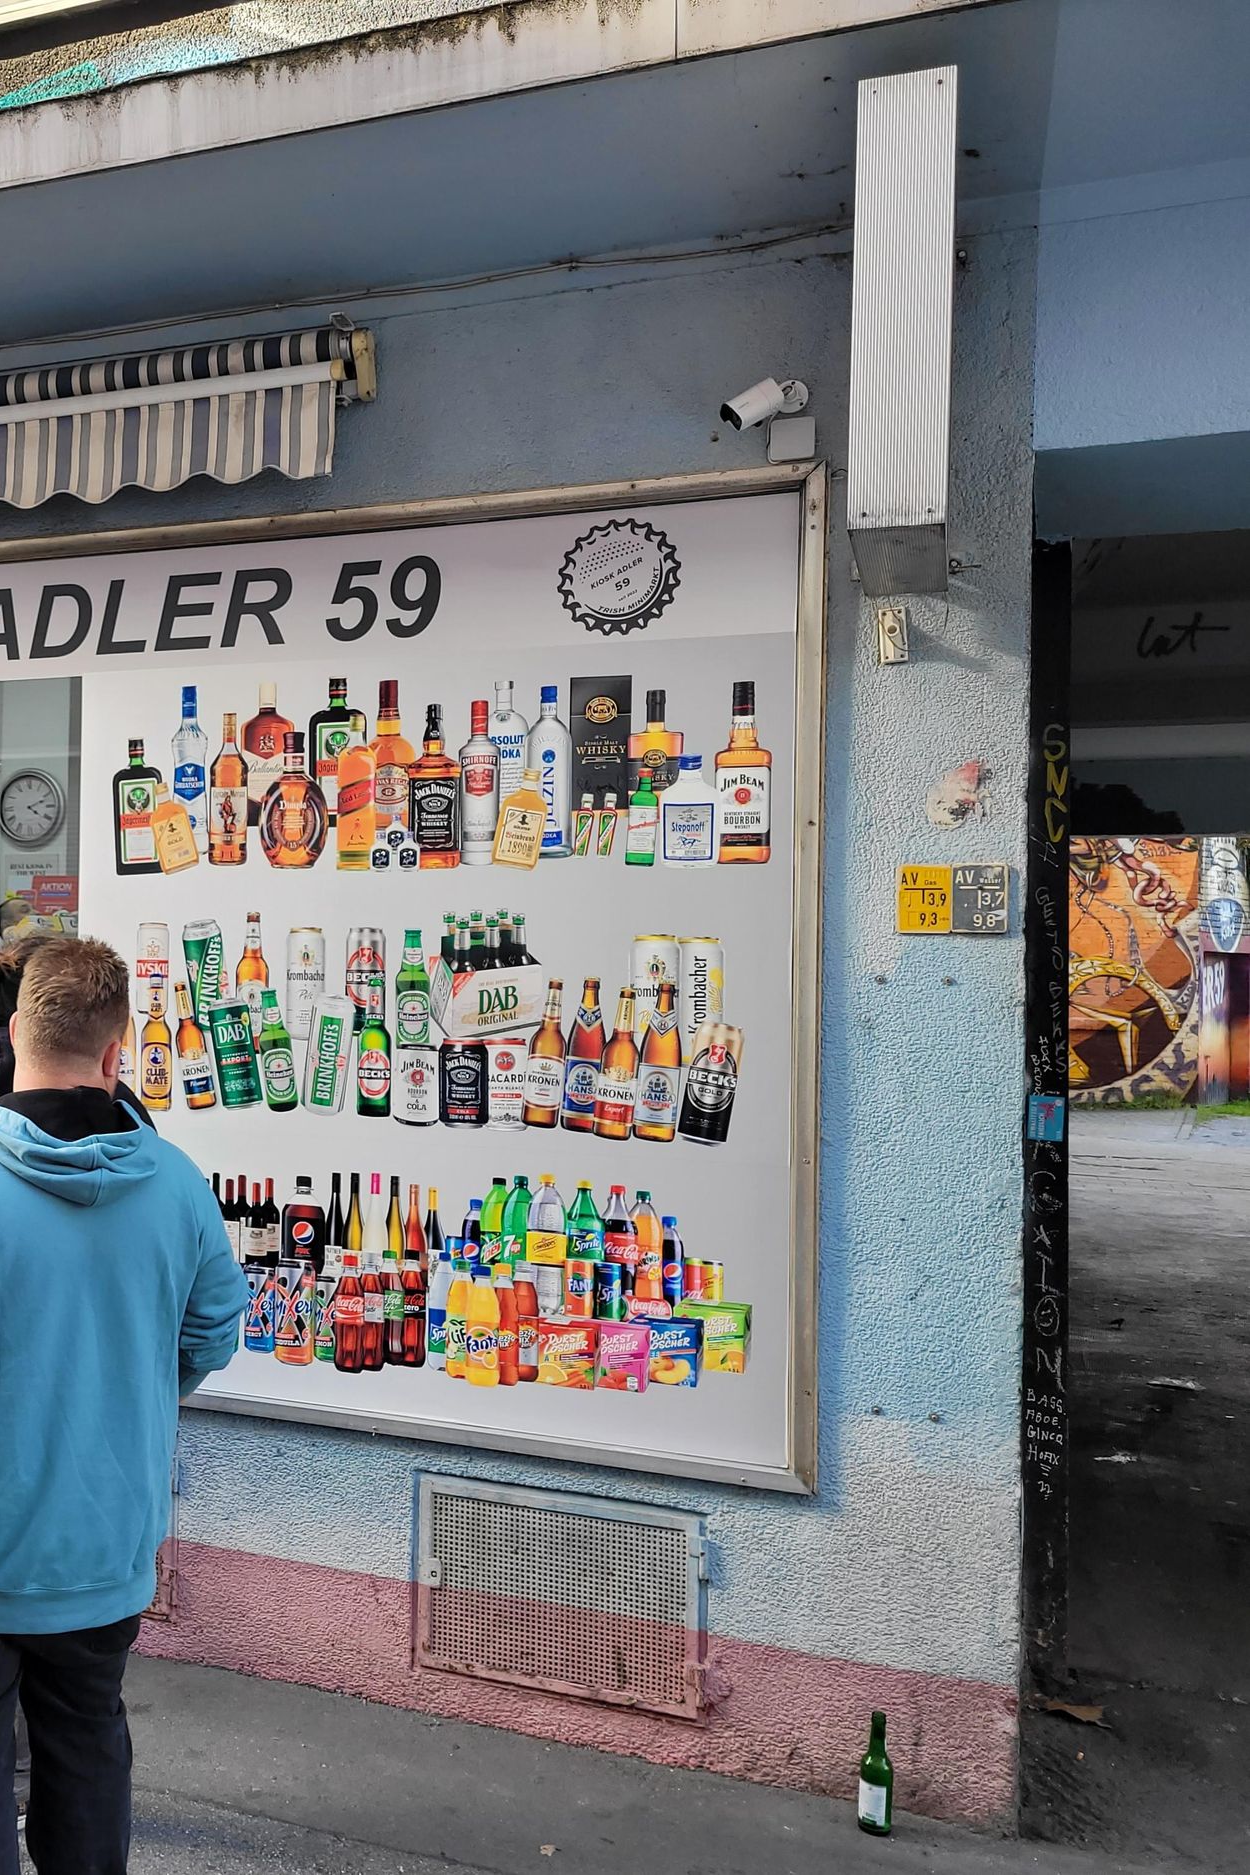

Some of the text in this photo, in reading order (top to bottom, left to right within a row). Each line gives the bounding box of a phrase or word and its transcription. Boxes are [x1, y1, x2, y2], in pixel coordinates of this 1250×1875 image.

[590, 557, 644, 589] KIOSK ADLER
[598, 567, 659, 614] TRISH MINIMARKT
[615, 578, 630, 591] 59
[325, 555, 442, 642] 59
[490, 735, 525, 745] BSOLUT
[499, 749, 521, 758] DKA
[575, 745, 627, 755] WHISKY
[462, 755, 498, 766] SMIRNOFF
[720, 774, 764, 792] JIM BEAM
[724, 815, 761, 825] BOURBON
[671, 822, 705, 833] Stepanoff
[955, 870, 975, 884] AV
[40, 883, 72, 891] AKTION
[478, 985, 518, 1015] DAB
[399, 1013, 428, 1021] Heineken
[477, 1011, 518, 1027] ORIGINAL
[218, 1022, 247, 1043] DAB
[400, 1058, 435, 1075] JIM BEAM
[358, 1069, 391, 1079] BECK'S
[689, 1069, 738, 1088] BECK'S
[145, 1076, 168, 1085] MATE
[527, 1075, 561, 1087] KRONEN
[599, 1088, 634, 1101] KRONEN
[698, 1086, 723, 1096] GOLD
[641, 1092, 673, 1103] HANSA
[406, 1103, 427, 1111] COLA
[574, 1235, 600, 1251] Sprite
[604, 1242, 639, 1260] Coca-Cola
[549, 1334, 585, 1346] DURST
[601, 1333, 633, 1345] DURST
[650, 1330, 685, 1342] DURST
